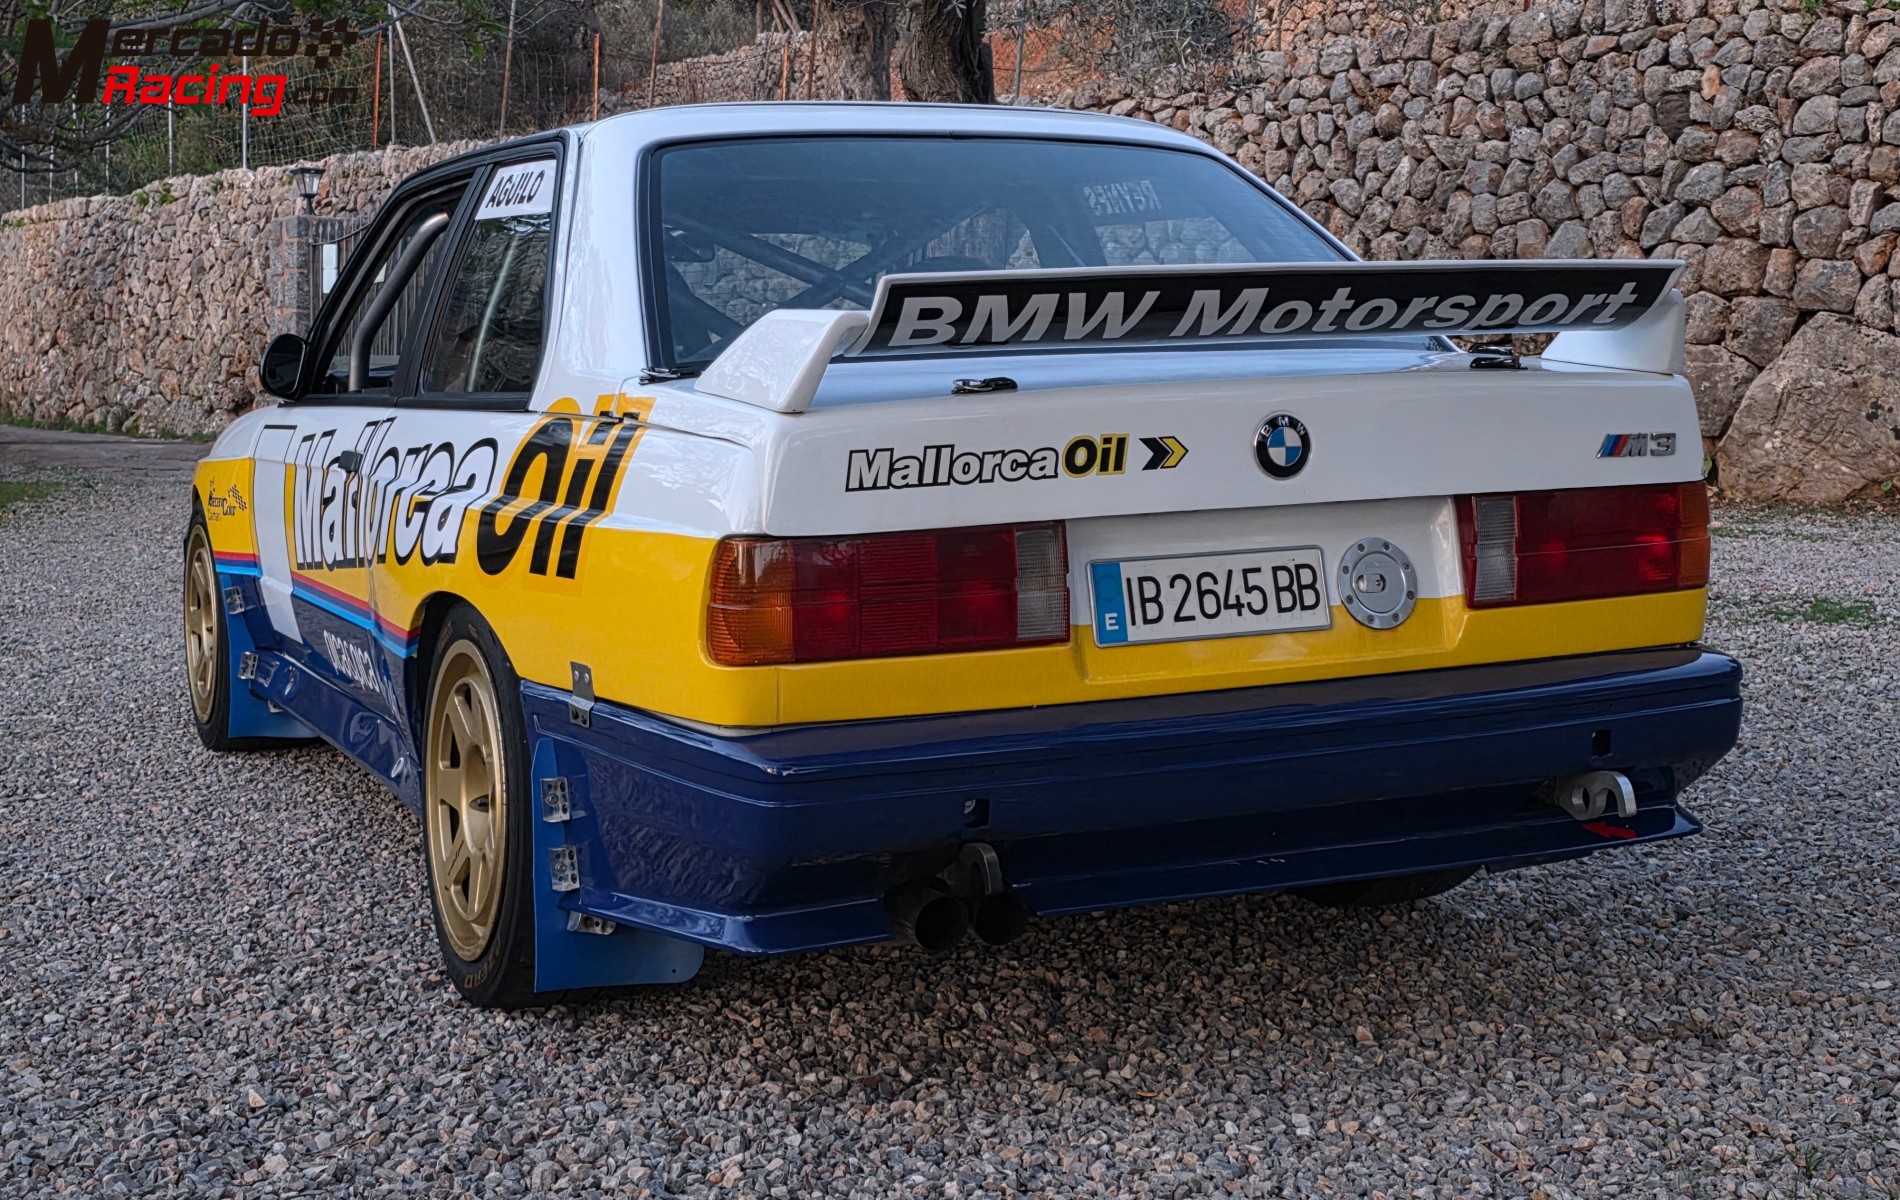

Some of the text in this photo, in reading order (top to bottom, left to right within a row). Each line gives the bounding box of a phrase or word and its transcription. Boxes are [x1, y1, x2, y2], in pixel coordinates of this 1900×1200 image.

[485, 170, 545, 209] AGUILO
[887, 281, 1639, 347] BMW Motorsport
[1260, 416, 1307, 437] BMW
[1600, 432, 1677, 458] M3
[1125, 563, 1321, 627] IB 2645 BB
[1104, 612, 1119, 631] E
